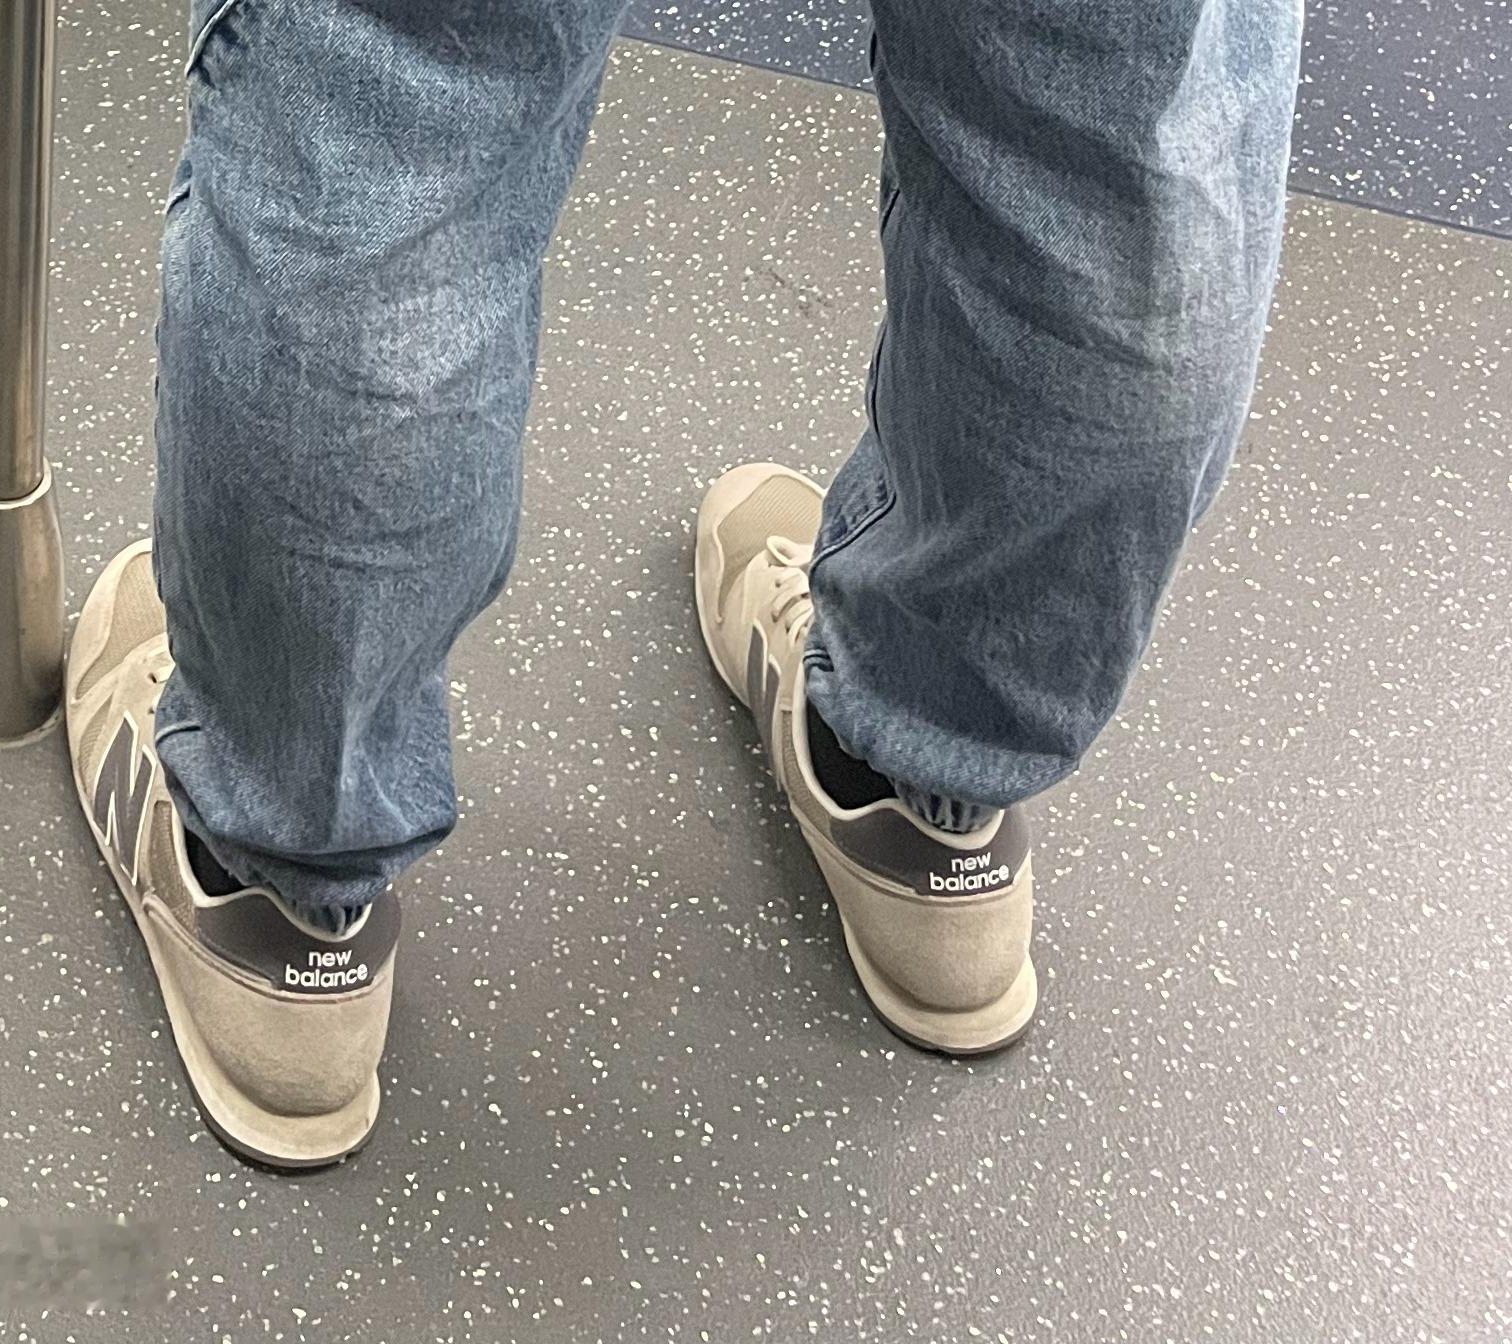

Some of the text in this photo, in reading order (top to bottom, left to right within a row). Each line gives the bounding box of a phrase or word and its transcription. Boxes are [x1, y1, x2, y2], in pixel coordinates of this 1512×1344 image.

[951, 852, 991, 872] new
[929, 864, 1009, 891] balance
[308, 949, 352, 967] new
[285, 963, 368, 988] balance
